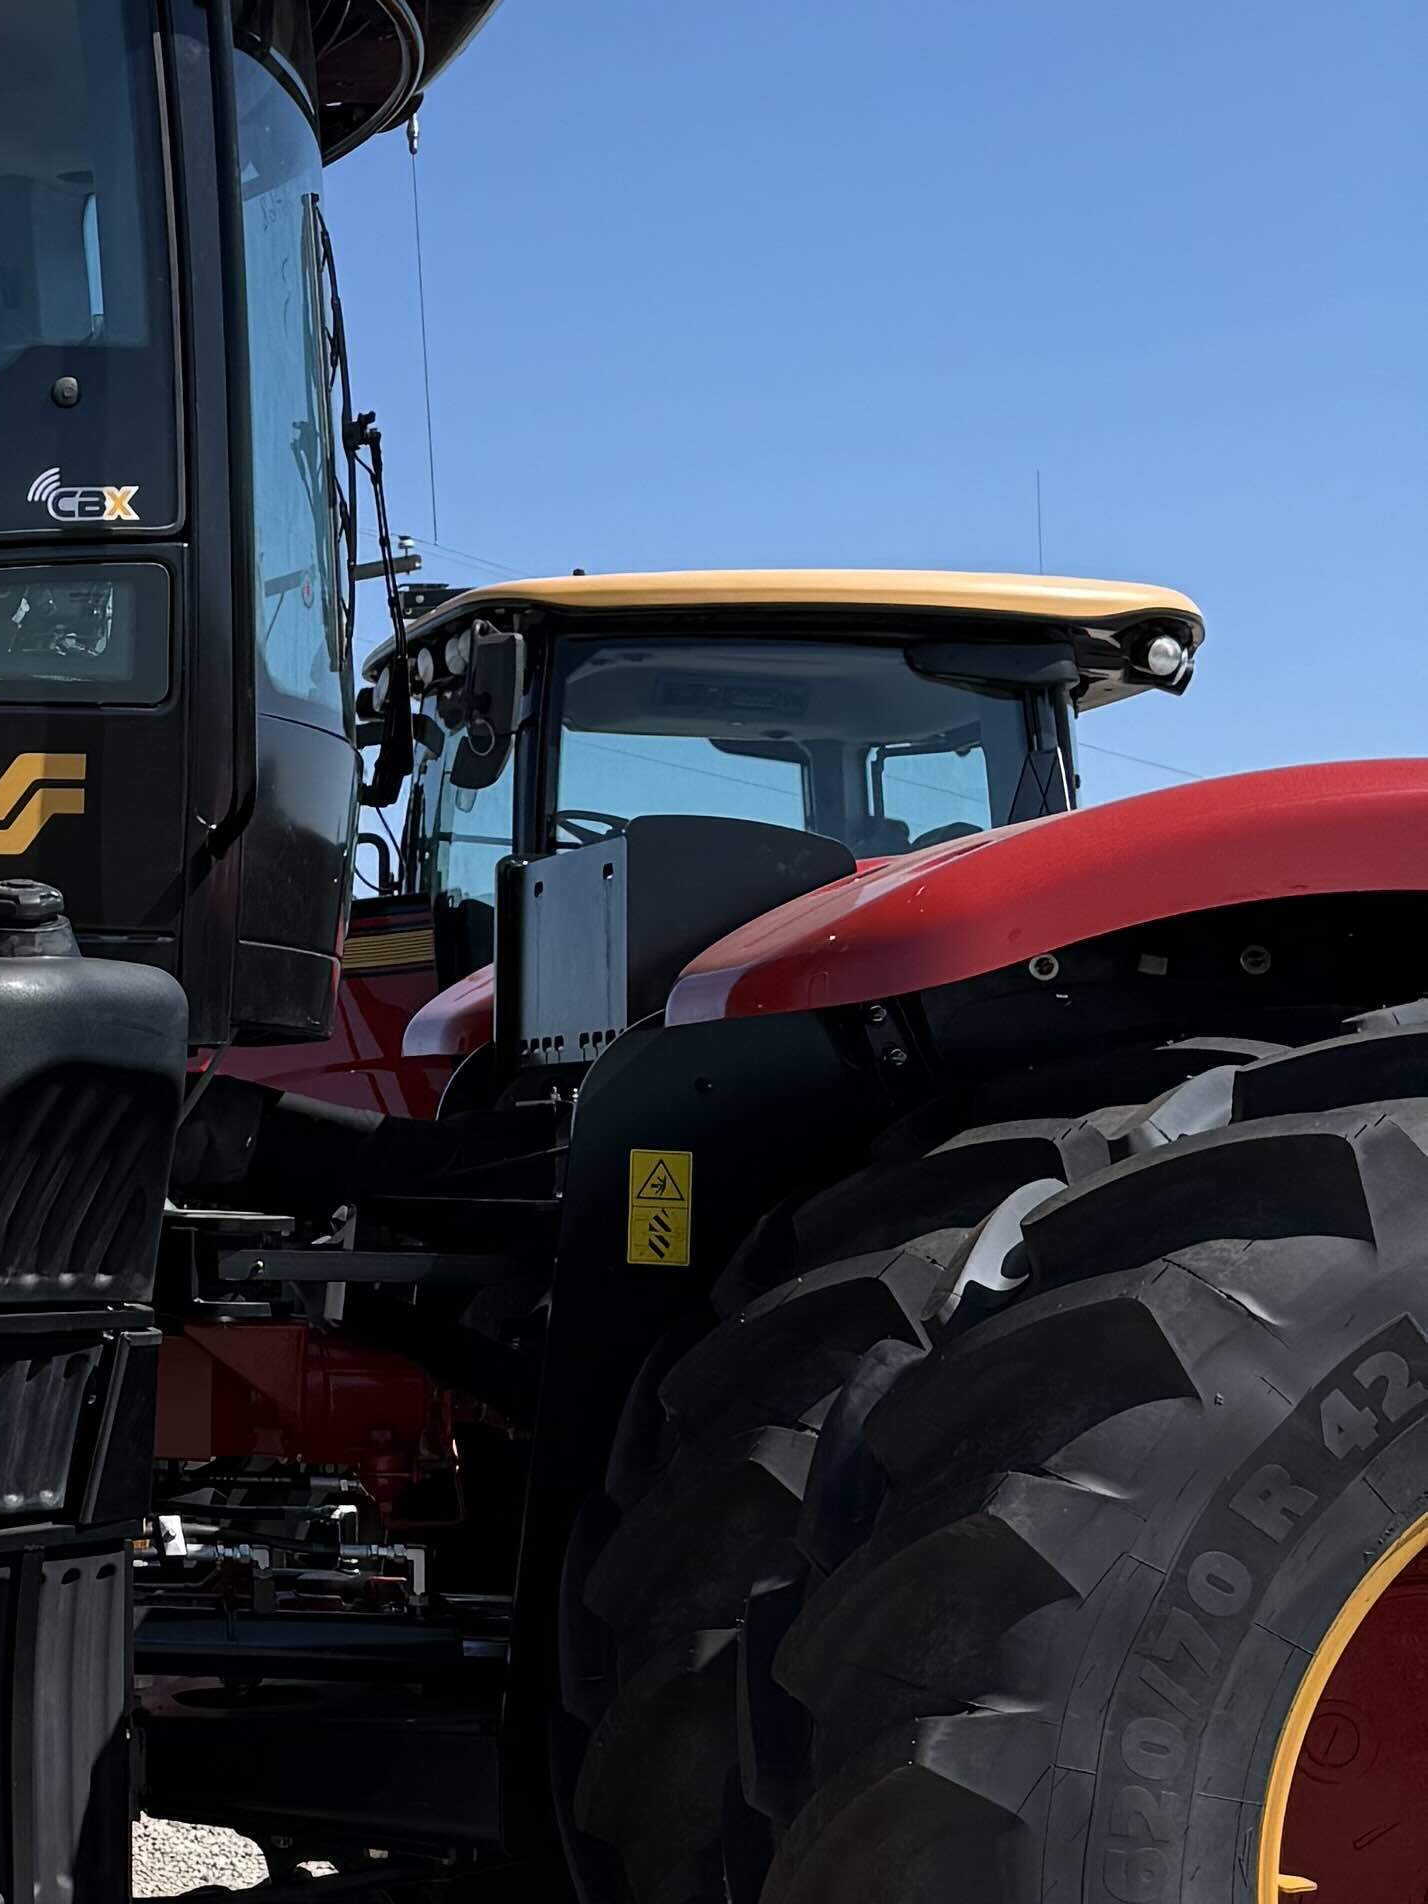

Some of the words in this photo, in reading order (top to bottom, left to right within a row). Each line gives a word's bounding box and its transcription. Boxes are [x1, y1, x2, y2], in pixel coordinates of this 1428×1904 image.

[1101, 1549, 1254, 1904] 620/70
[1228, 1463, 1319, 1544] R
[1319, 1350, 1428, 1459] 42
